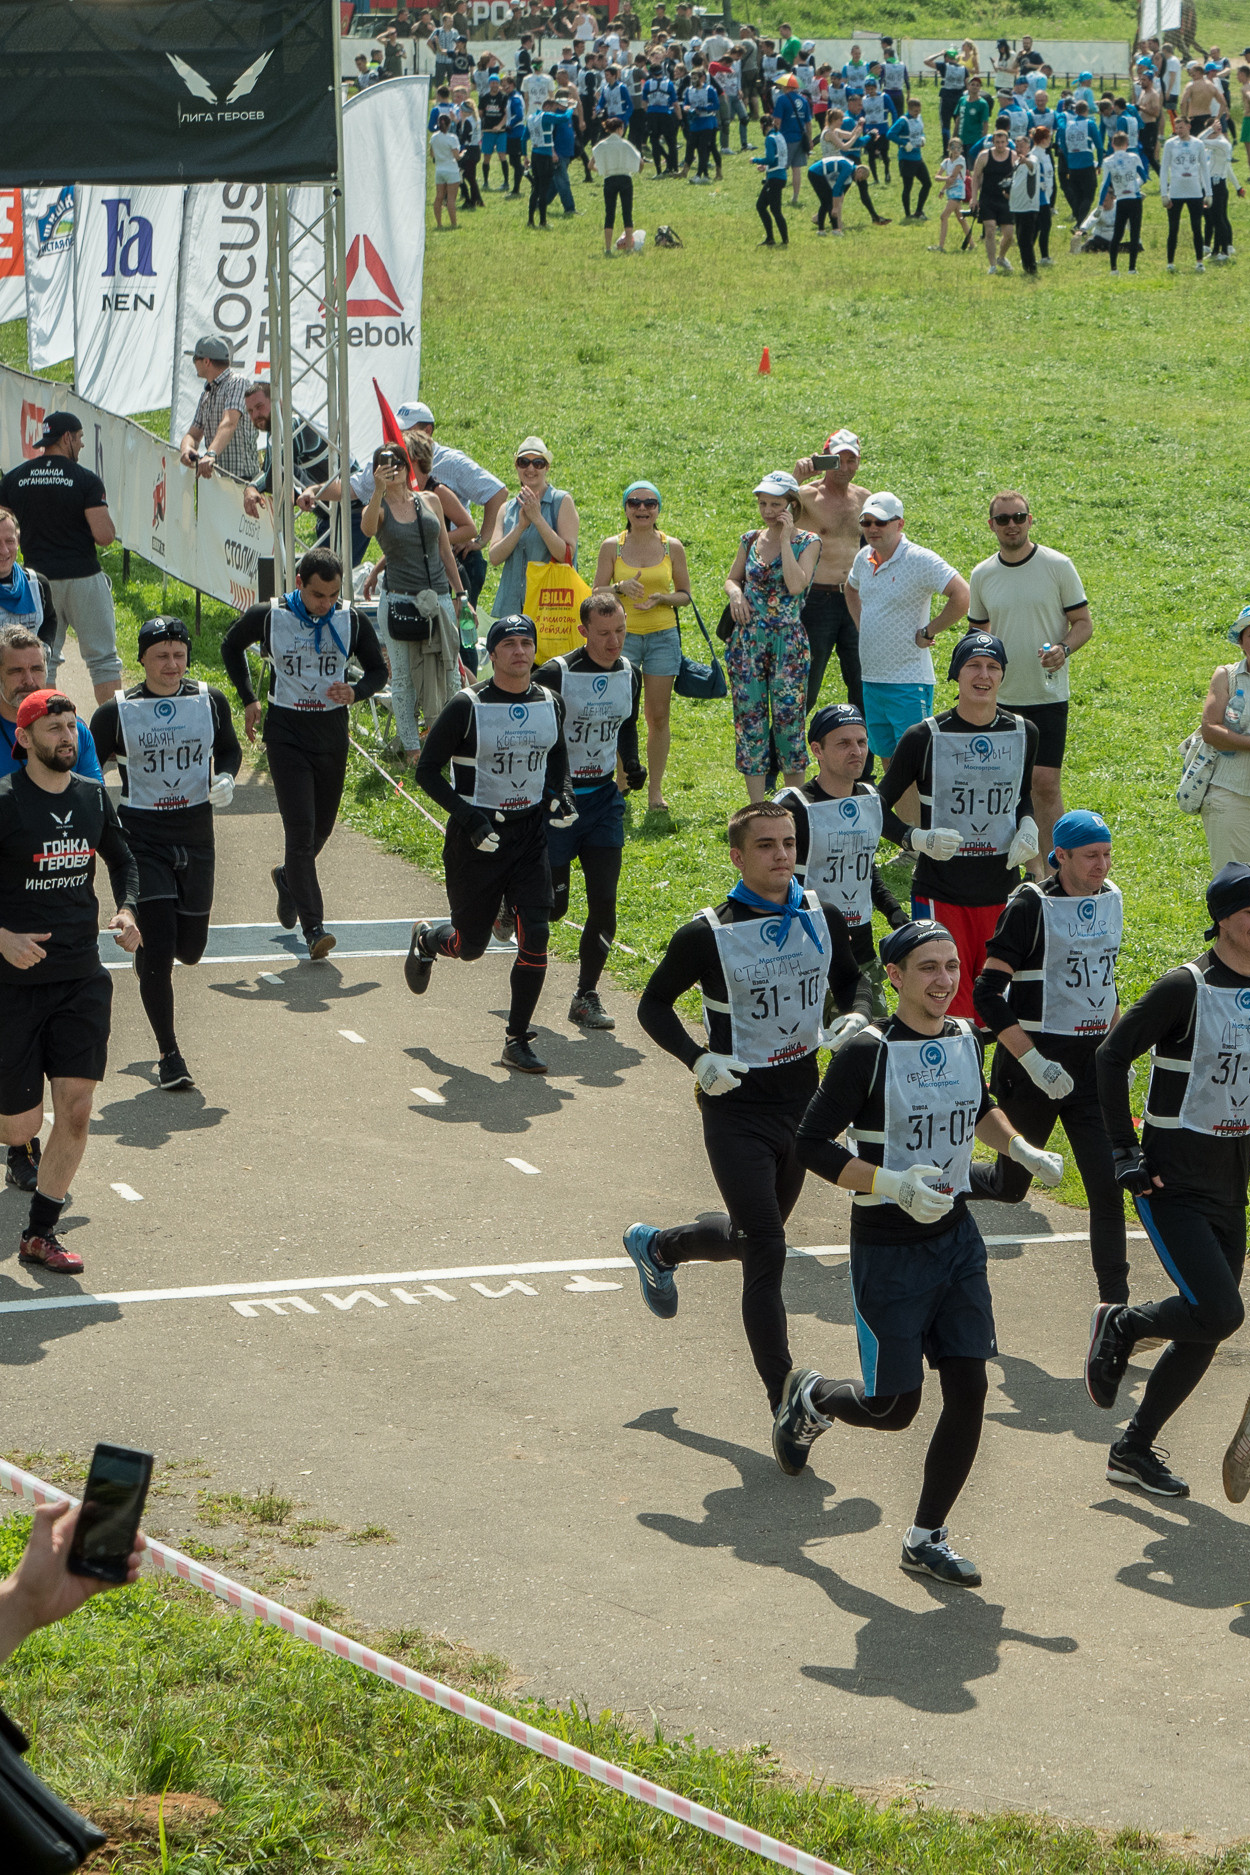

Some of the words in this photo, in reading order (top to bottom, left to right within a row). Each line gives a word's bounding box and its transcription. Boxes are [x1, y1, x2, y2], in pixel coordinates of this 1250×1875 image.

[181, 112, 214, 123] ЛИГА
[217, 110, 265, 121] ГЕРОЕВ
[44, 194, 74, 237] ШИШК
[101, 199, 157, 278] Fa
[213, 183, 264, 368] ROCUS
[305, 321, 416, 349] Rebok
[30, 467, 64, 477] КОМАНДА
[18, 477, 74, 488] ОРГАНИЗАТОРОВ
[541, 590, 572, 605] BILLA
[283, 655, 337, 677] 31-16
[138, 731, 175, 747] КОЛЯН
[143, 744, 203, 773] 31-04
[491, 750, 546, 774] 31-01
[964, 764, 1001, 772] Мосгортранс
[950, 787, 1013, 815] 31-02
[43, 838, 90, 857] ГОНКА
[38, 853, 91, 872] ГЕРОЕВ
[758, 951, 804, 965] Мосгортранс
[733, 958, 802, 984] СТЕПАН
[750, 974, 820, 1020] 31-10
[774, 1041, 802, 1057] ГОНКА
[918, 1078, 960, 1089] Мосгортранс
[906, 1107, 978, 1151] 31-05
